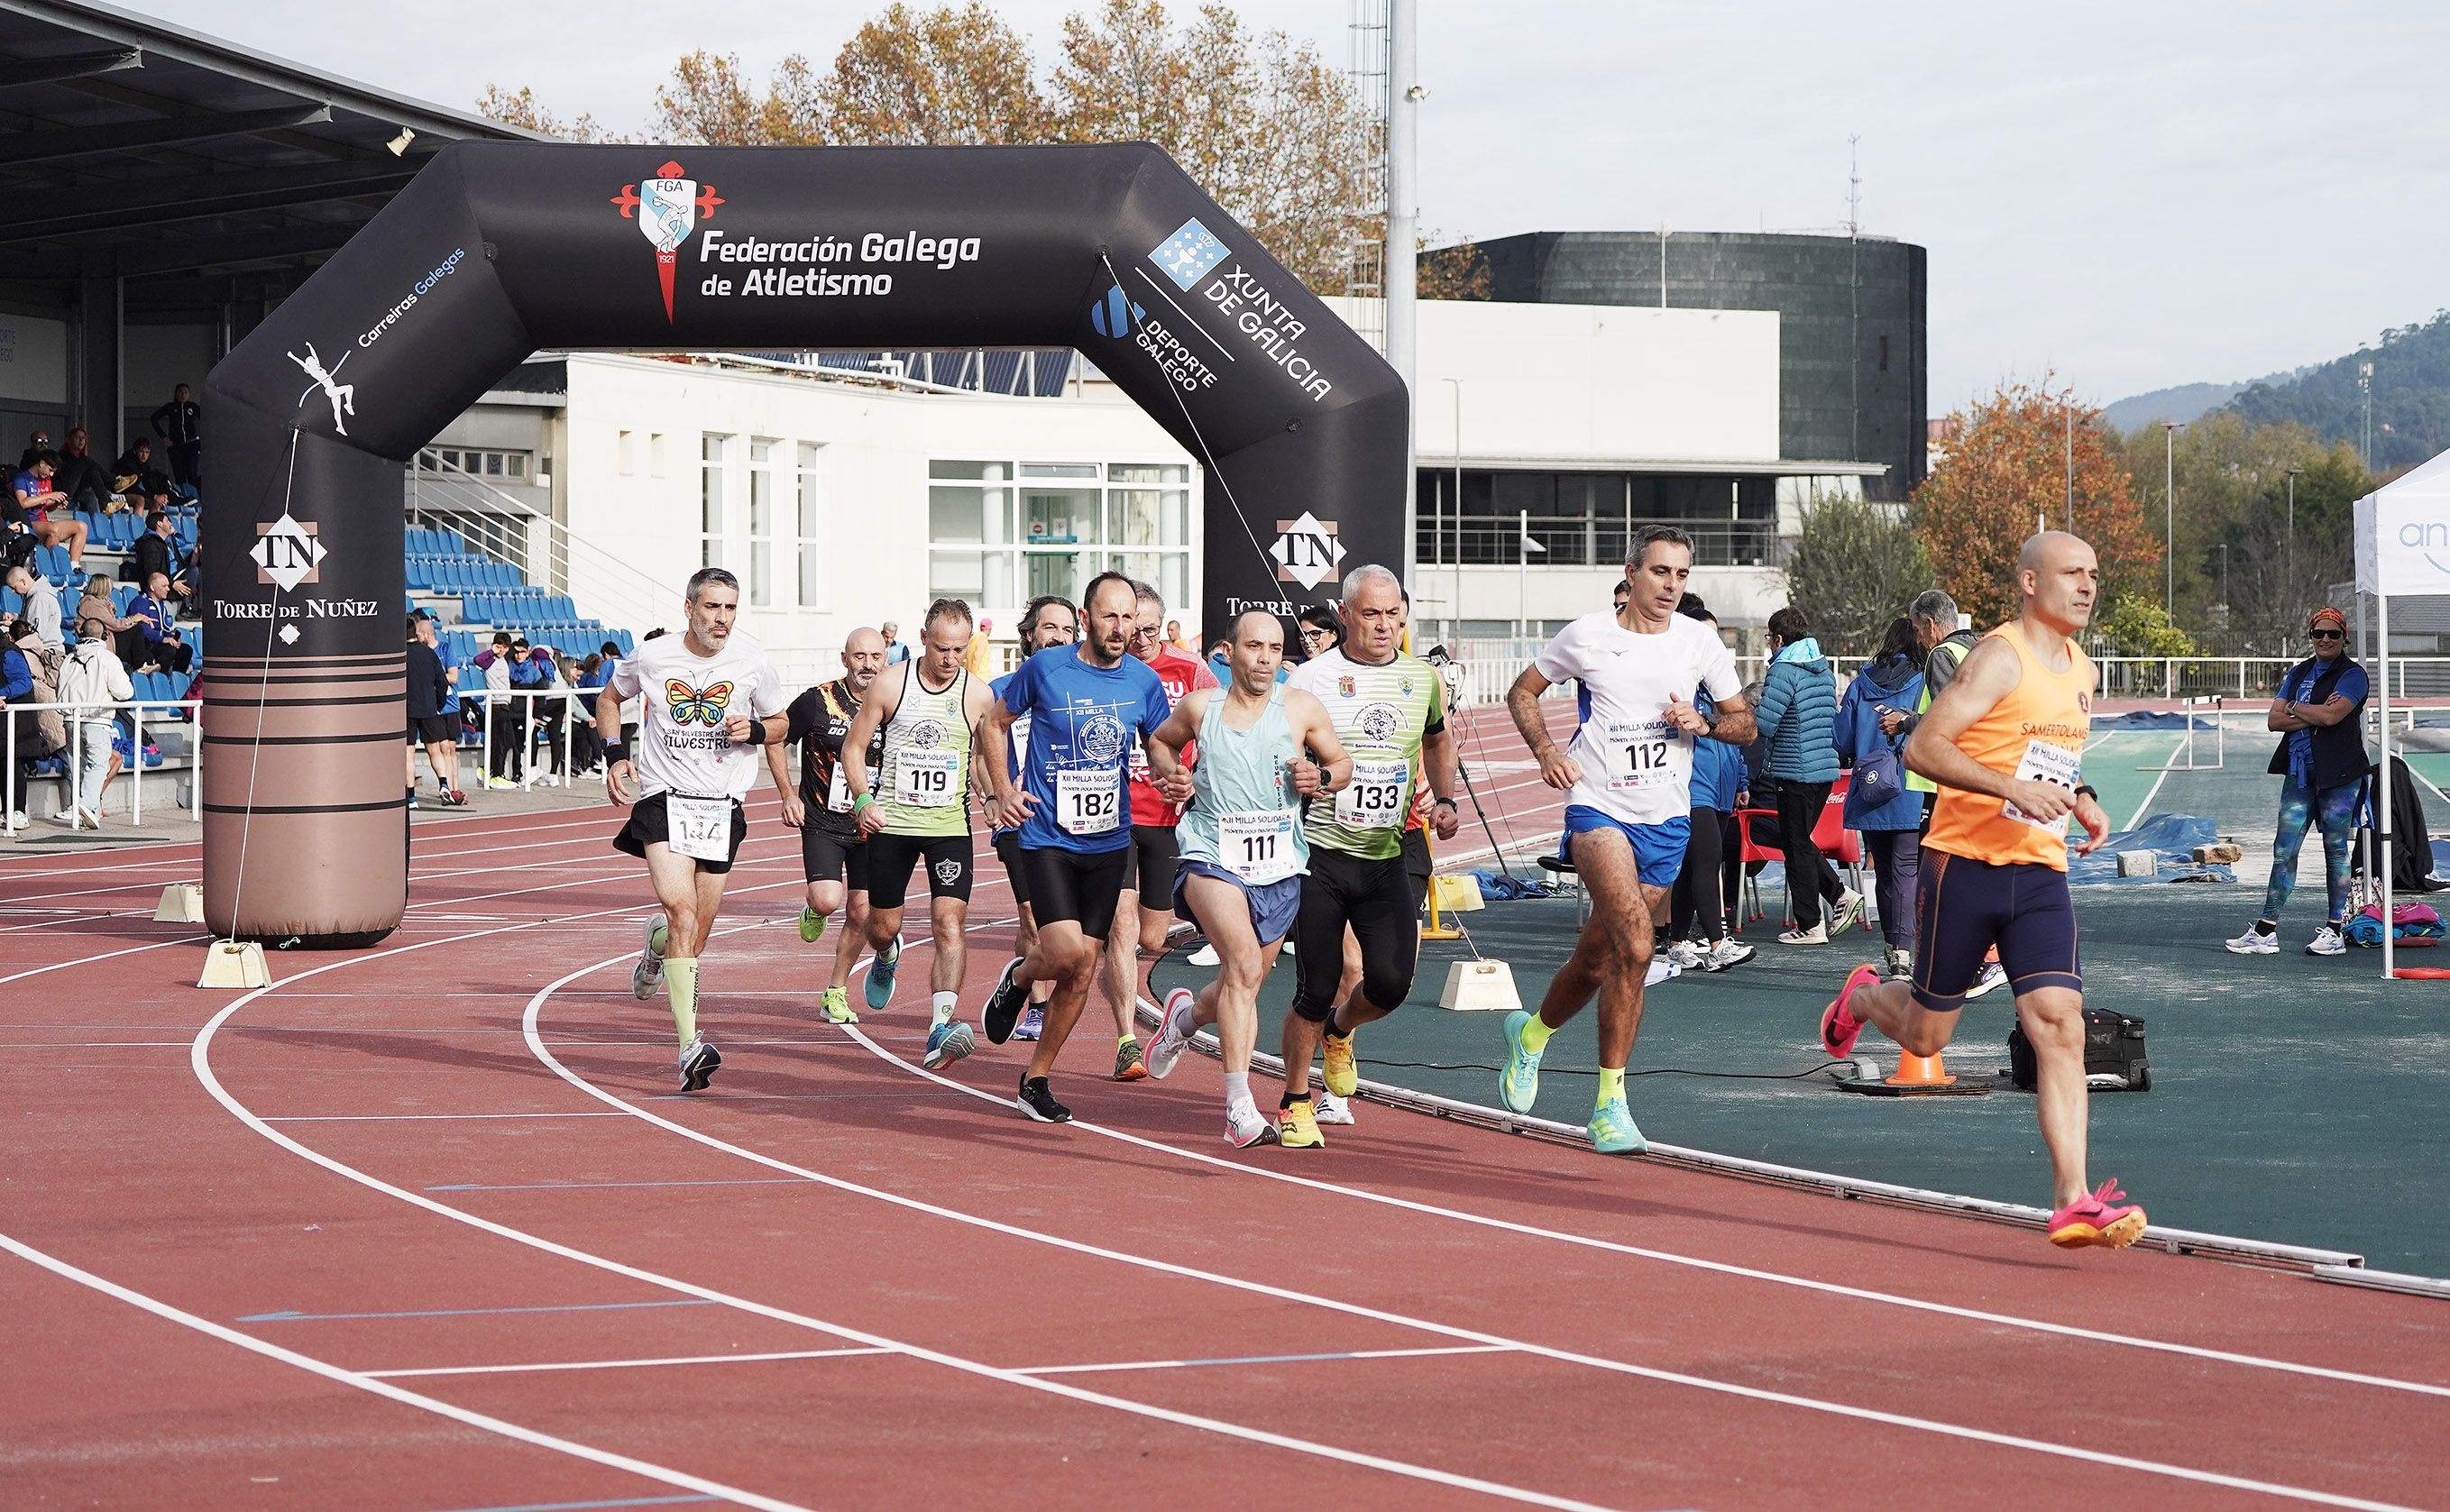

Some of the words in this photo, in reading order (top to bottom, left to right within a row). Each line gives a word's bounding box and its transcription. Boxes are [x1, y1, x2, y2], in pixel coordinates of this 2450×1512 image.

[656, 180, 683, 192] FGA
[658, 255, 674, 263] 1921
[700, 230, 853, 262] Federación
[859, 230, 981, 270] Galega
[701, 274, 731, 296] de
[741, 268, 893, 296] Atletismo
[358, 292, 418, 348] Carreiras
[414, 247, 465, 296] Galegas
[1223, 263, 1307, 342] XUNTA
[1204, 279, 1243, 316] DE
[1238, 311, 1333, 402] GALICIA
[1135, 333, 1197, 391] GALEGO
[1146, 320, 1218, 389] DEPORTE
[257, 535, 317, 568] TN
[1276, 533, 1337, 567] TN
[214, 600, 272, 619] TORRE
[279, 606, 300, 618] DE
[306, 598, 378, 619] NUÑEZ
[1619, 724, 1641, 733] MILLA
[664, 735, 730, 749] SILVESTRE
[910, 752, 927, 760] MILLA
[1626, 742, 1666, 770] 112
[911, 770, 946, 791] 119
[1072, 774, 1092, 783] MILLA
[1072, 793, 1115, 816] 182
[1353, 784, 1398, 809] 133
[1235, 816, 1256, 824] MILLA
[1243, 835, 1275, 862] 111
